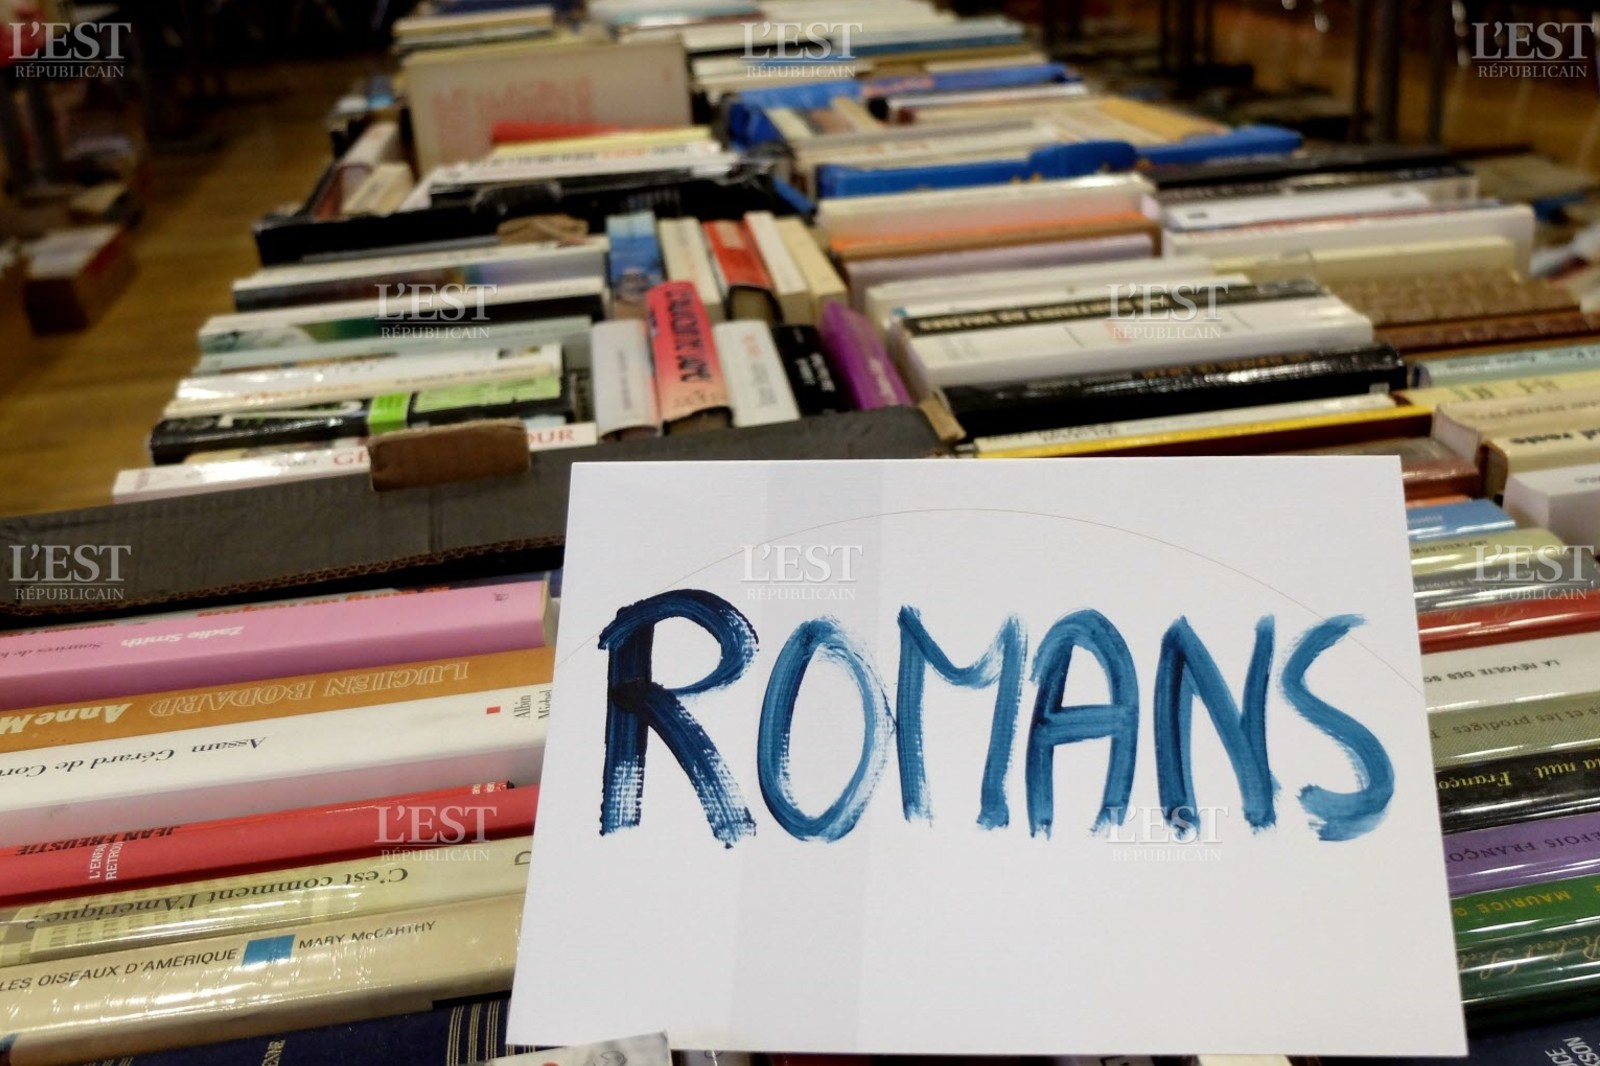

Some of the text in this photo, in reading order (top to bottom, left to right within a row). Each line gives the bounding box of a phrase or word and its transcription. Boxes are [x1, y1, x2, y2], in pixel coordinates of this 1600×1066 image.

[121, 632, 184, 648] Smith
[187, 625, 245, 639] Zadie
[323, 661, 469, 697] LUCIEN
[150, 680, 316, 717] BODARD
[514, 694, 531, 720] Albin
[35, 702, 134, 724] Anne
[597, 588, 1395, 849] ROMANS
[1452, 715, 1532, 734] prodiges
[192, 736, 267, 753] Assam
[55, 759, 84, 773] de
[90, 748, 175, 770] Gérard
[1534, 761, 1577, 779] nuit
[121, 825, 182, 842] JEAN
[343, 867, 409, 886] C'est
[208, 876, 334, 903] comment
[43, 894, 196, 924] l'Amérique
[1477, 890, 1572, 914] MAURICE
[0, 977, 33, 992] LES
[38, 965, 120, 988] OISEAUX
[125, 948, 239, 974] D'AMERIQUE
[299, 933, 346, 950] MARY
